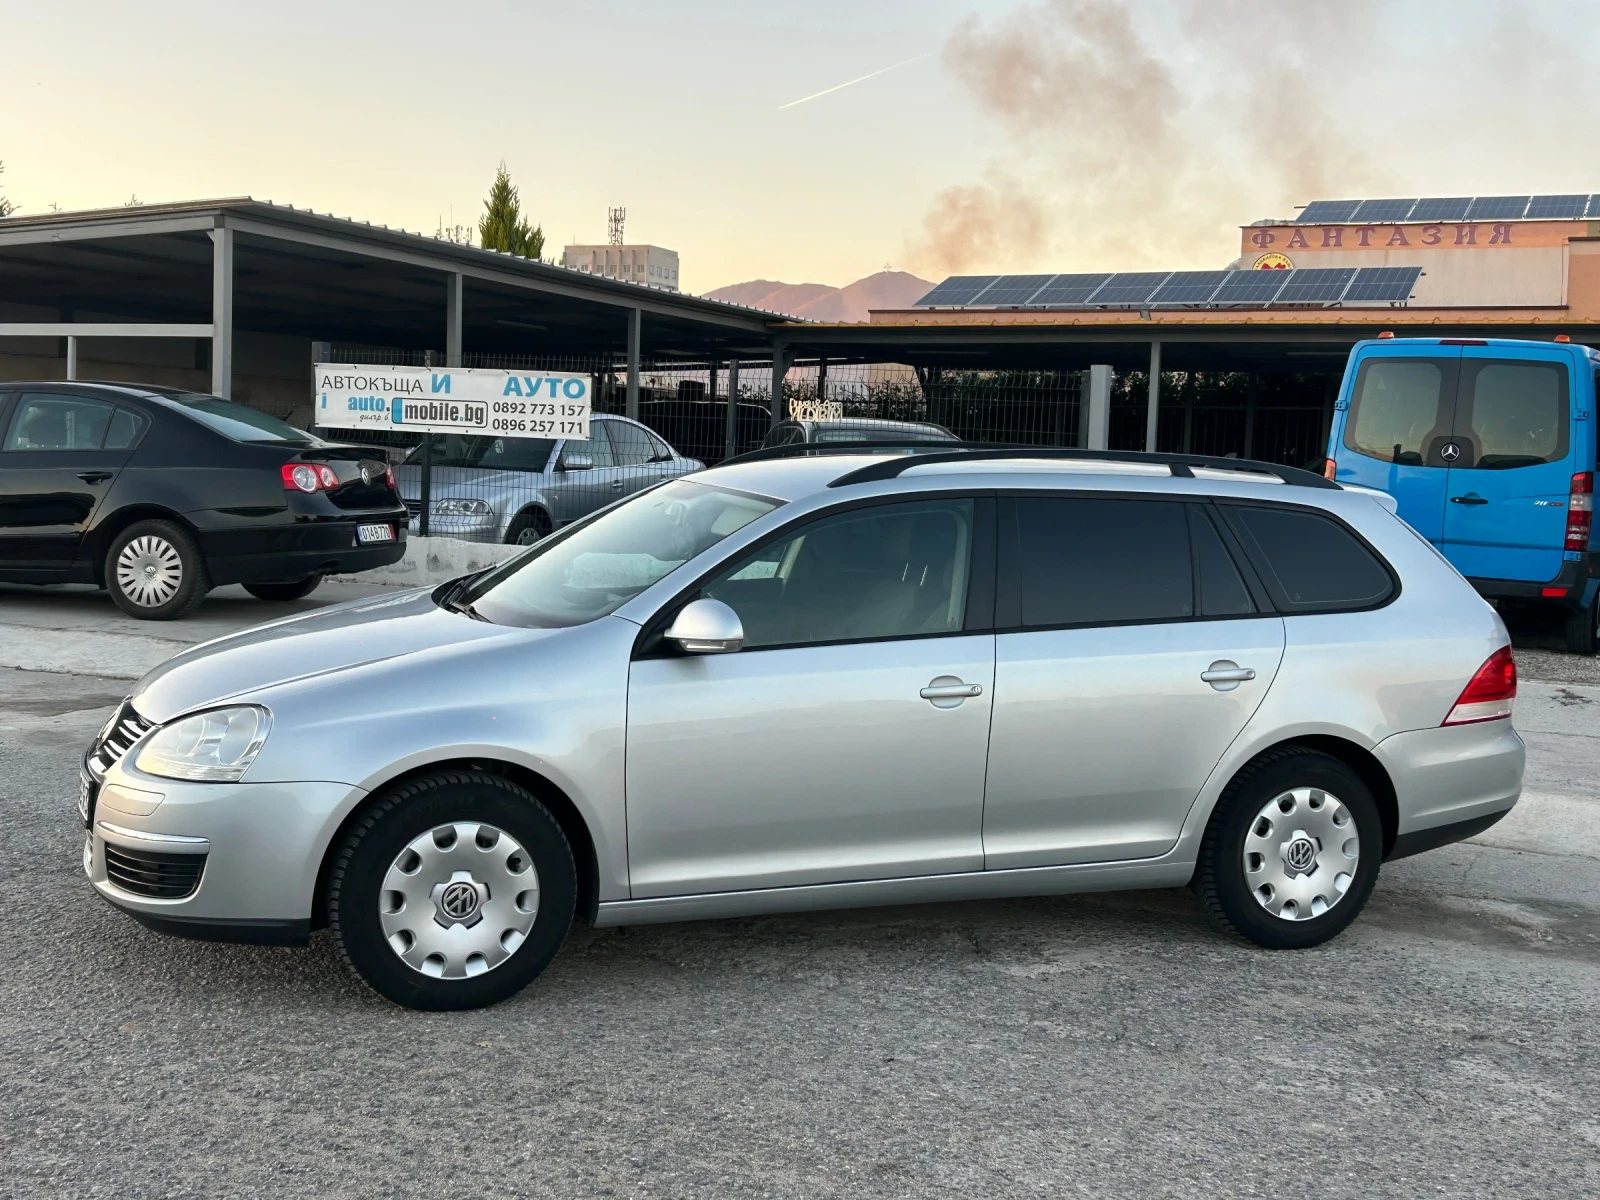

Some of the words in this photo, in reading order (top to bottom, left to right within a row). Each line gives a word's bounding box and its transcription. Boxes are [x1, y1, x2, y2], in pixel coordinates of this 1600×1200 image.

[1251, 223, 1513, 248] ФАНТАЗИЯ
[321, 375, 424, 395] АВТОКЪЩА
[431, 373, 451, 394] И
[502, 376, 586, 399] АУТО
[404, 402, 484, 425] mobile.bg
[492, 401, 527, 414] 0892
[530, 403, 555, 415] 773
[560, 404, 585, 417] 157
[492, 418, 526, 431] 0896
[529, 420, 555, 433] 257
[559, 421, 583, 434] 171
